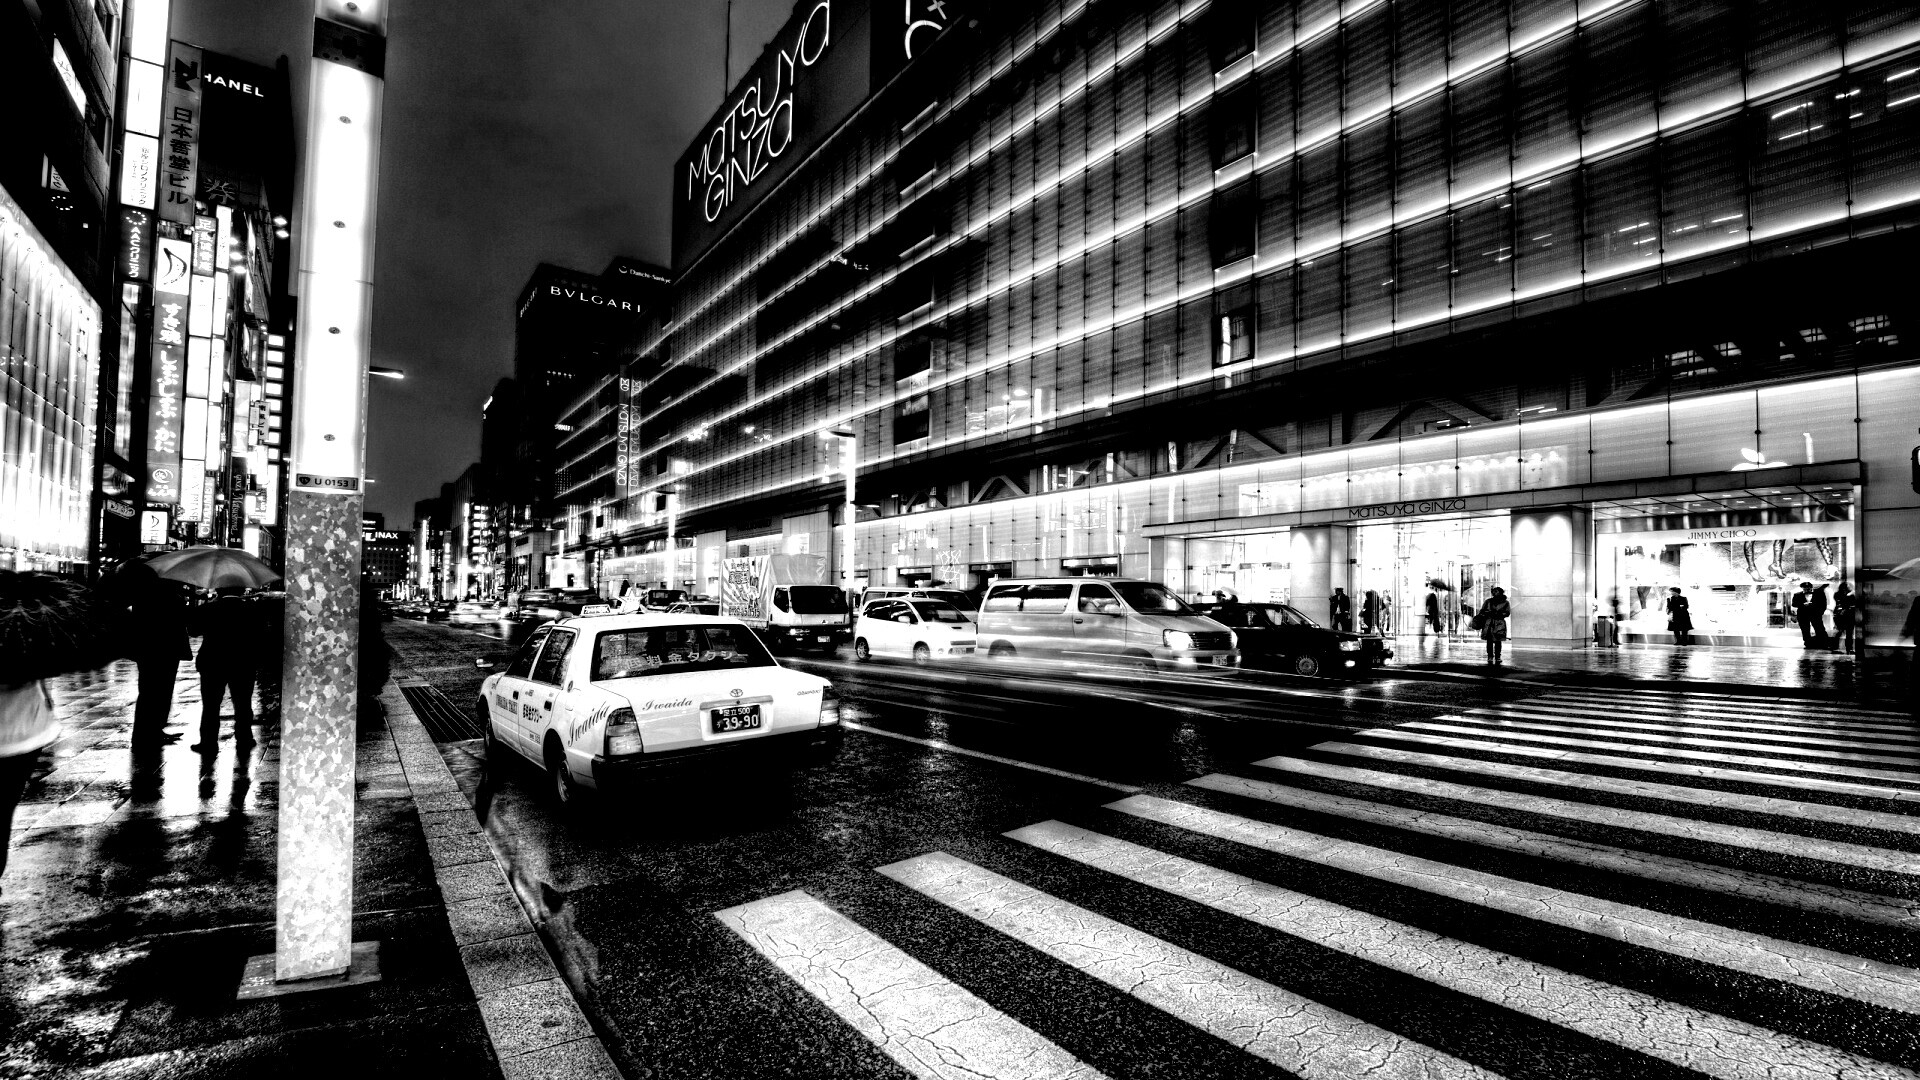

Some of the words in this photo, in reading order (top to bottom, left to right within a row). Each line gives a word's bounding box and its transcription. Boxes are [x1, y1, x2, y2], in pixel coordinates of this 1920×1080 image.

[204, 73, 264, 97] HANEL
[168, 106, 193, 204] 日本香堂ビル
[550, 285, 641, 313] BVLGARI
[314, 477, 322, 485] U
[324, 478, 349, 488] 0153
[375, 531, 398, 540] INAX
[1687, 530, 1718, 540] JIMMY
[1720, 528, 1757, 538] CHOO
[642, 697, 693, 711] Iwaida
[737, 706, 751, 715] 500
[567, 701, 611, 748] Iwaida
[722, 714, 759, 730] 39-90
